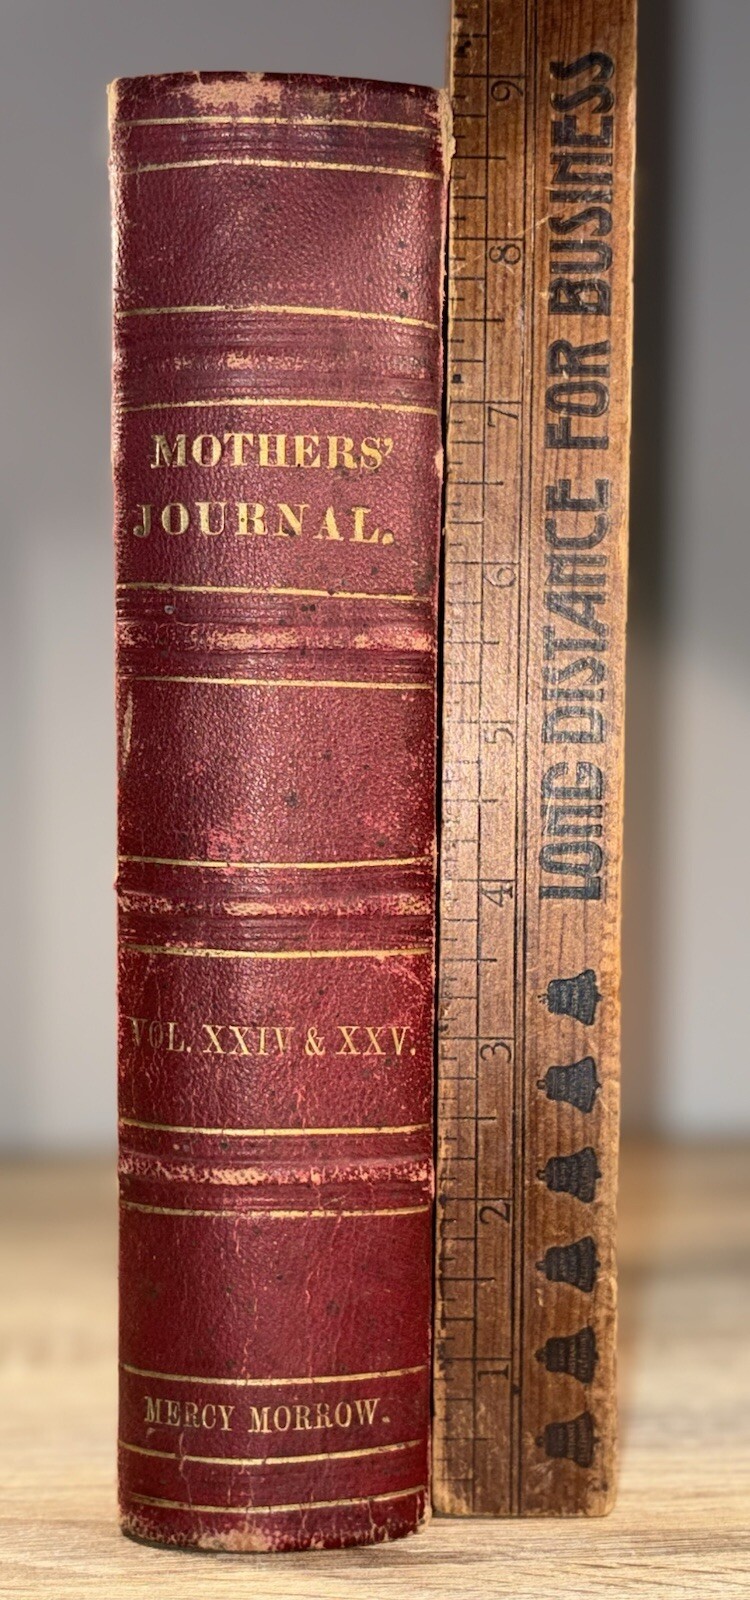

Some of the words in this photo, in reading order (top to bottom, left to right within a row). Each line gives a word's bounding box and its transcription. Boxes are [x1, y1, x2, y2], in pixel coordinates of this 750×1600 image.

[490, 80, 524, 103] 9
[548, 51, 616, 316] BUSINESS
[489, 244, 521, 265] 8
[546, 339, 612, 450] FOR
[487, 406, 520, 430] 7
[133, 502, 395, 545] JOURNAL.
[482, 566, 517, 589] 6
[543, 478, 608, 744] DISTANCE
[484, 724, 515, 746] 5
[539, 761, 603, 901] LONG
[480, 880, 514, 908] 4
[127, 1016, 192, 1053] VOL.
[202, 1024, 295, 1056] XXIV
[305, 1026, 326, 1056] &
[337, 1026, 417, 1056] XXV.
[480, 1042, 512, 1063] 3
[479, 1203, 511, 1225] 2
[478, 1363, 509, 1382] 1
[144, 1396, 235, 1431] MERCY
[247, 1398, 391, 1434] MORROW.
